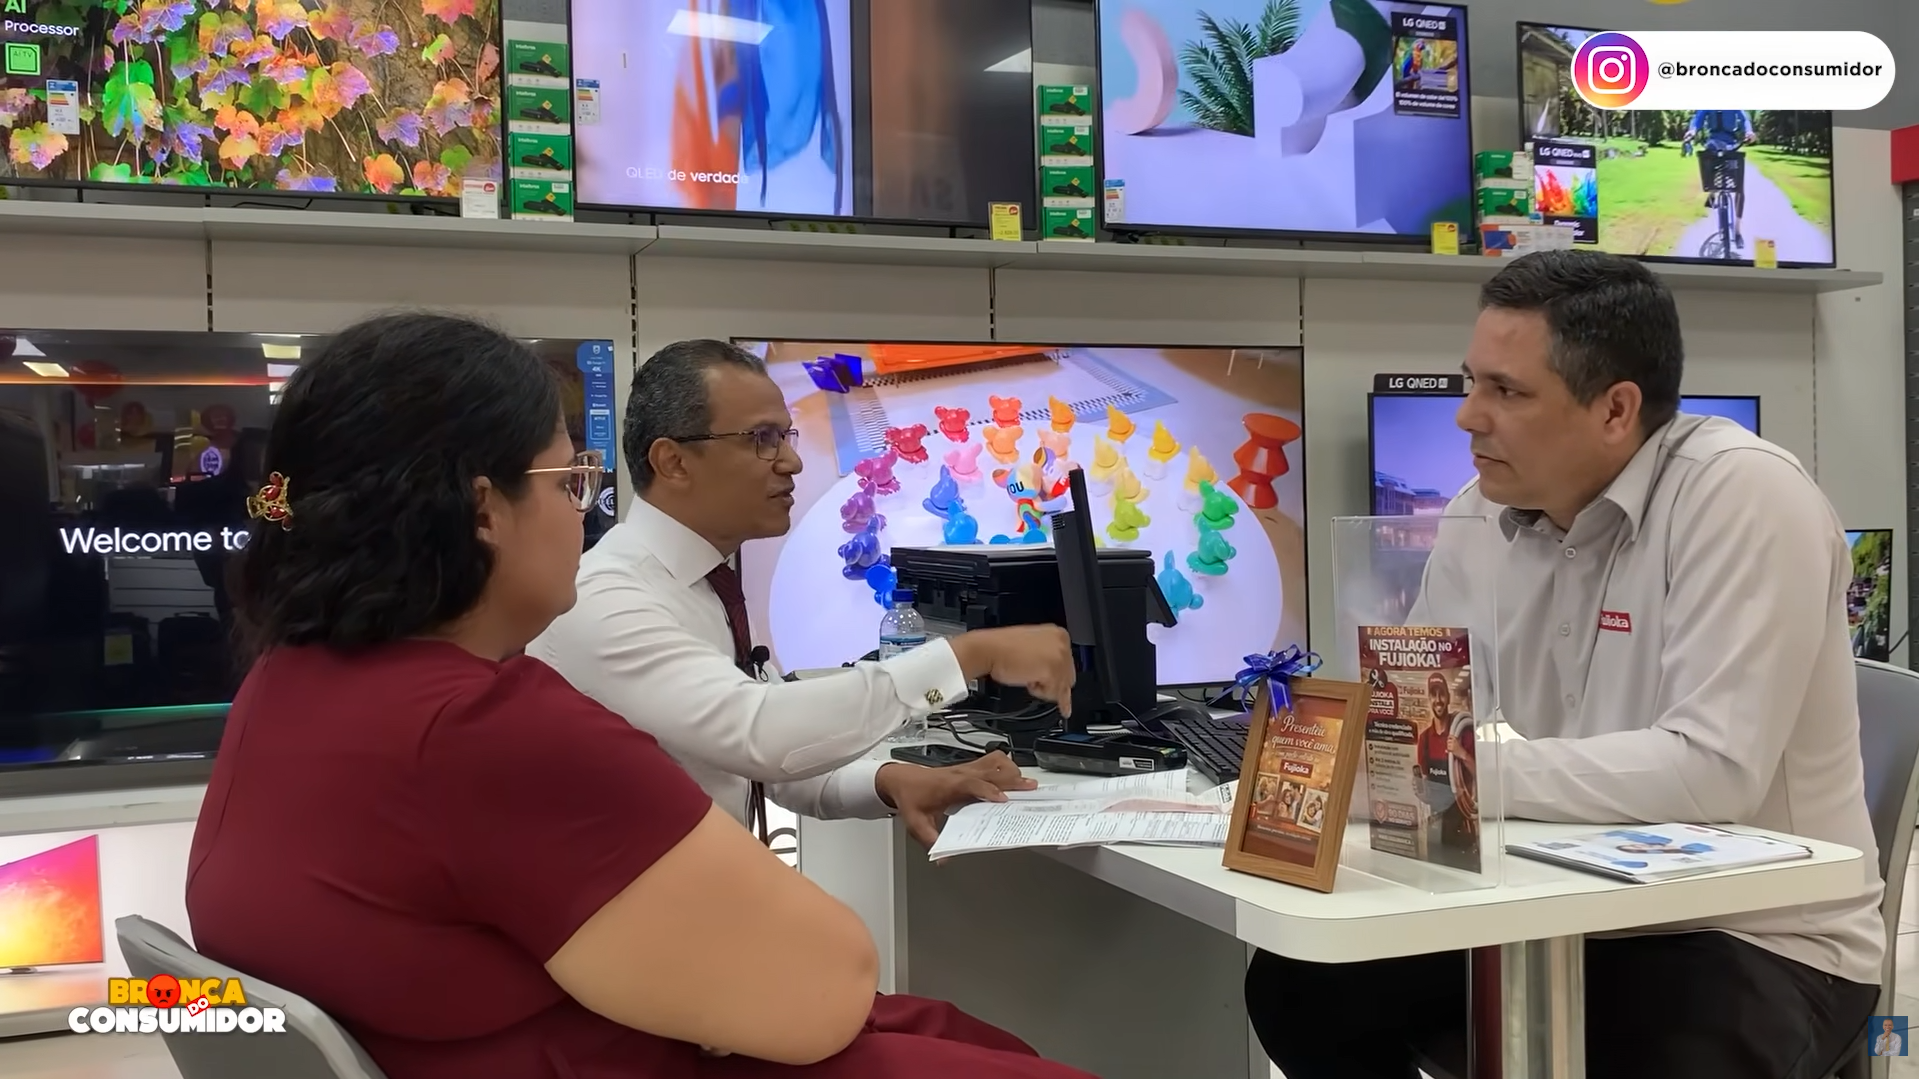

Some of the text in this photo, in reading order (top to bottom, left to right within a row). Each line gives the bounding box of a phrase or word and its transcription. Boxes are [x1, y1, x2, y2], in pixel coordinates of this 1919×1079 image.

[4, 0, 27, 14] AI
[4, 19, 80, 37] Processor
[1402, 17, 1414, 28] LG
[1415, 18, 1438, 30] QNED
[1539, 147, 1551, 157] LG
[1551, 147, 1573, 158] QNED
[667, 169, 687, 181] de
[689, 171, 749, 185] verdade
[1388, 377, 1404, 389] LG
[1406, 377, 1438, 389] QNED
[59, 526, 251, 554] Welcome to
[1601, 613, 1629, 628] ujioka
[1373, 626, 1443, 637] AGORA TEMOS
[1369, 637, 1453, 653] INSTALAÇÃO NO
[1379, 651, 1441, 668] FUJIOKA!
[1371, 691, 1394, 699] UJIOKA
[1271, 735, 1294, 748] quem
[1294, 738, 1315, 749] você
[1283, 762, 1310, 774] Fujioka
[1429, 767, 1447, 776] Fujioka
